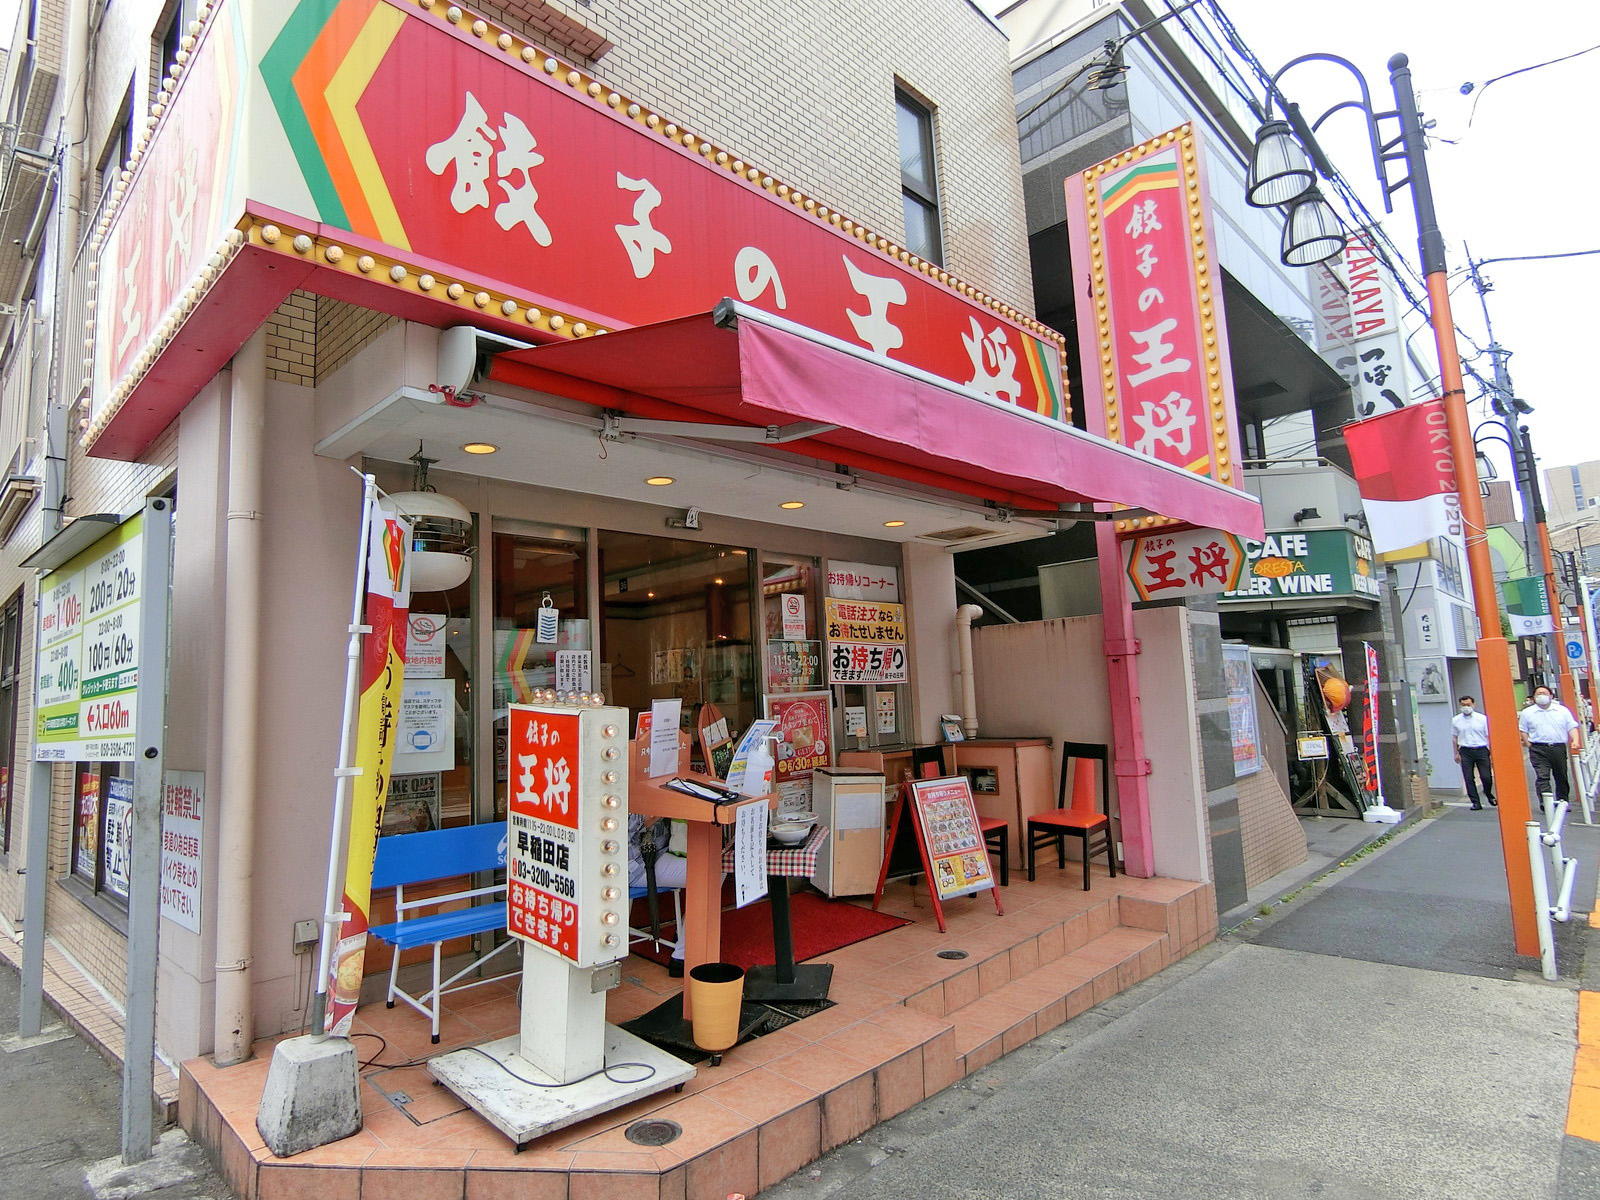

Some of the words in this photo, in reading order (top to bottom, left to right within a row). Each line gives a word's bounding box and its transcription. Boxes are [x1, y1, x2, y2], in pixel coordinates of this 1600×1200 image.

[425, 90, 1022, 404] 餃子の王将
[1125, 200, 1197, 457] 餃子の王将
[1423, 400, 1455, 473] TOKYO
[1439, 480, 1461, 536] 2020
[1144, 538, 1175, 552] 餃子の
[1246, 534, 1308, 559] CAFE
[828, 571, 895, 590] お持帰りコーナー
[1144, 541, 1230, 593] 王将
[1277, 574, 1333, 594] WINE
[829, 621, 905, 641] お待たせしません
[832, 644, 905, 671] お持ち帰り
[526, 719, 561, 747] 餃子の
[165, 783, 201, 821] 駐輪禁止
[515, 752, 572, 816] 王将
[517, 829, 570, 872] 早稲田店
[517, 859, 576, 899] 03-3200-5568
[512, 883, 575, 927] お持ち帰り
[512, 905, 570, 951] できます。
